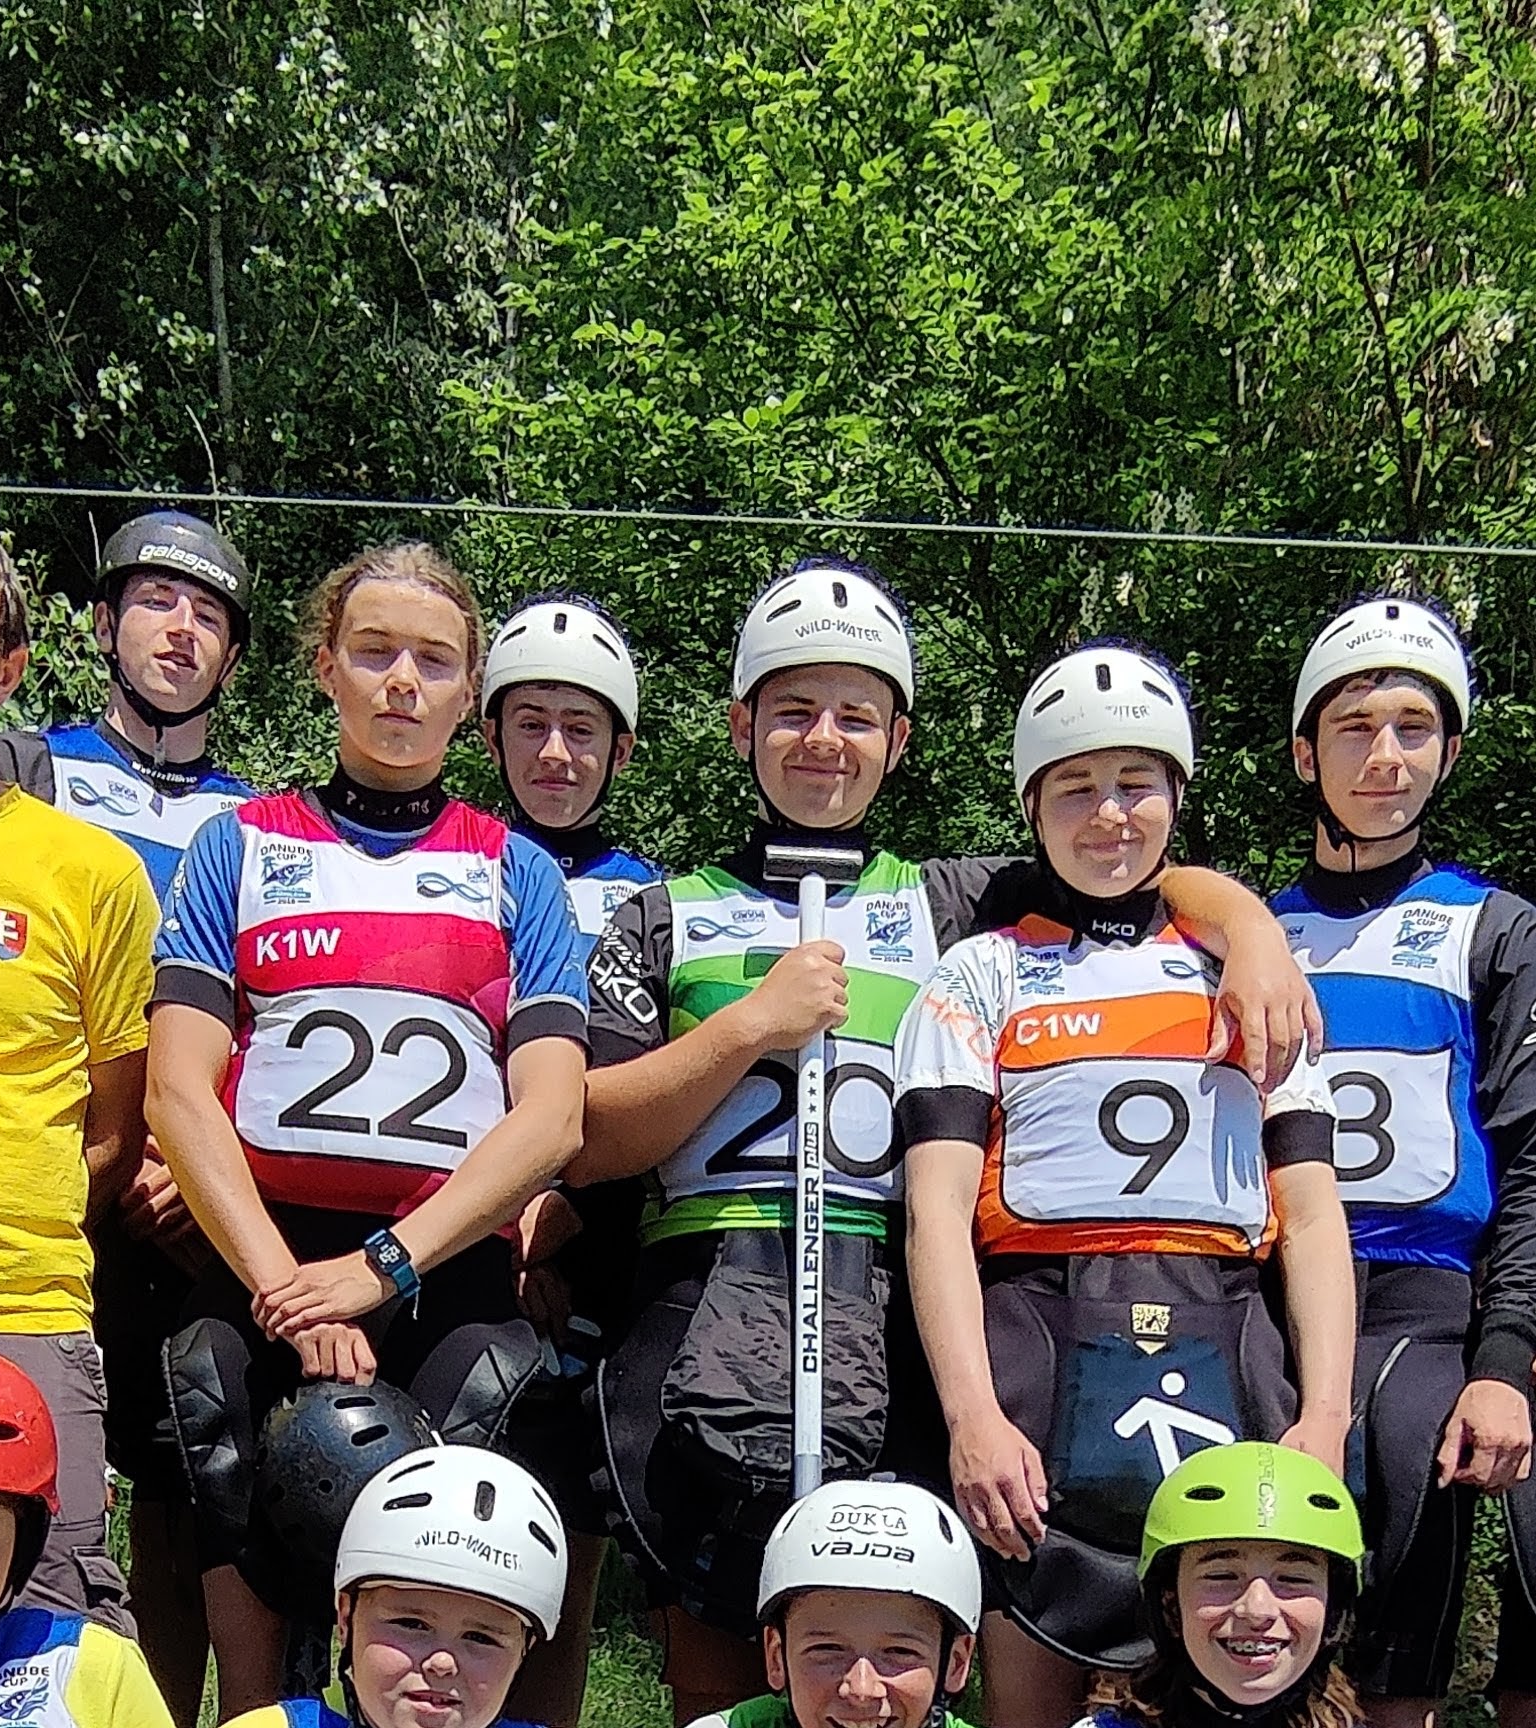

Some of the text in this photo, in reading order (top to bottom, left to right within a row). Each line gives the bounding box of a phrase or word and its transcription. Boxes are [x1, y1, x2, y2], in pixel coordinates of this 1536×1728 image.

[138, 544, 238, 591] galasport
[794, 618, 882, 642] WILD-WATER
[1402, 908, 1454, 926] DANUBE
[1416, 919, 1436, 927] CUP
[256, 927, 342, 966] K1W
[1015, 1012, 1102, 1047] C1W
[277, 1009, 468, 1149] 22
[704, 1058, 904, 1179] 20
[1098, 1078, 1190, 1196] 9
[1327, 1070, 1397, 1182] 3
[802, 1121, 819, 1374] CHALLENGER plus
[830, 1511, 907, 1530] DUKLA
[1, 1677, 28, 1688] CUP
